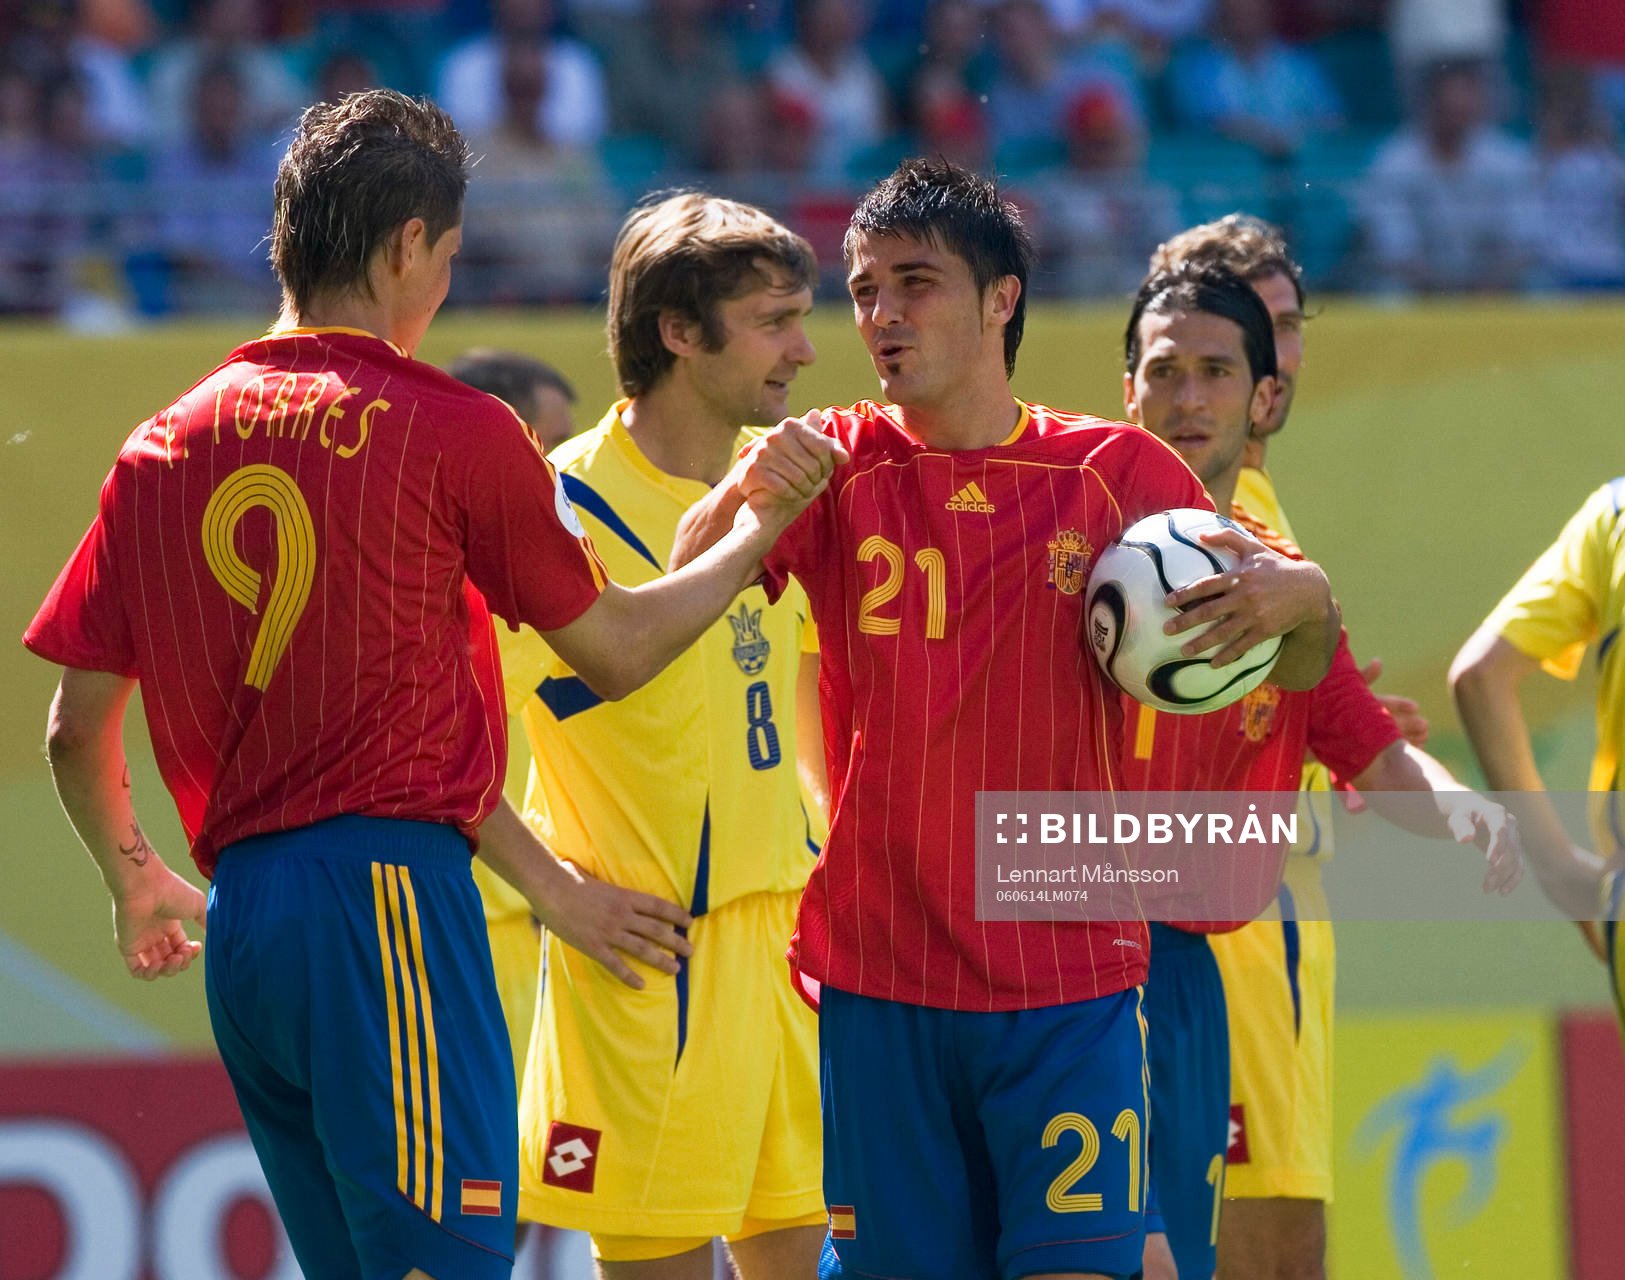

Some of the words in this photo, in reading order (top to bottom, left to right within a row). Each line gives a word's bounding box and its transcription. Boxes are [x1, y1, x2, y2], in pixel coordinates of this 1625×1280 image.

[212, 371, 392, 460] TORRES
[944, 500, 996, 514] adidas
[201, 463, 317, 692] 9
[856, 534, 947, 640] 21
[746, 680, 781, 771] 8
[1041, 1108, 1142, 1213] 21
